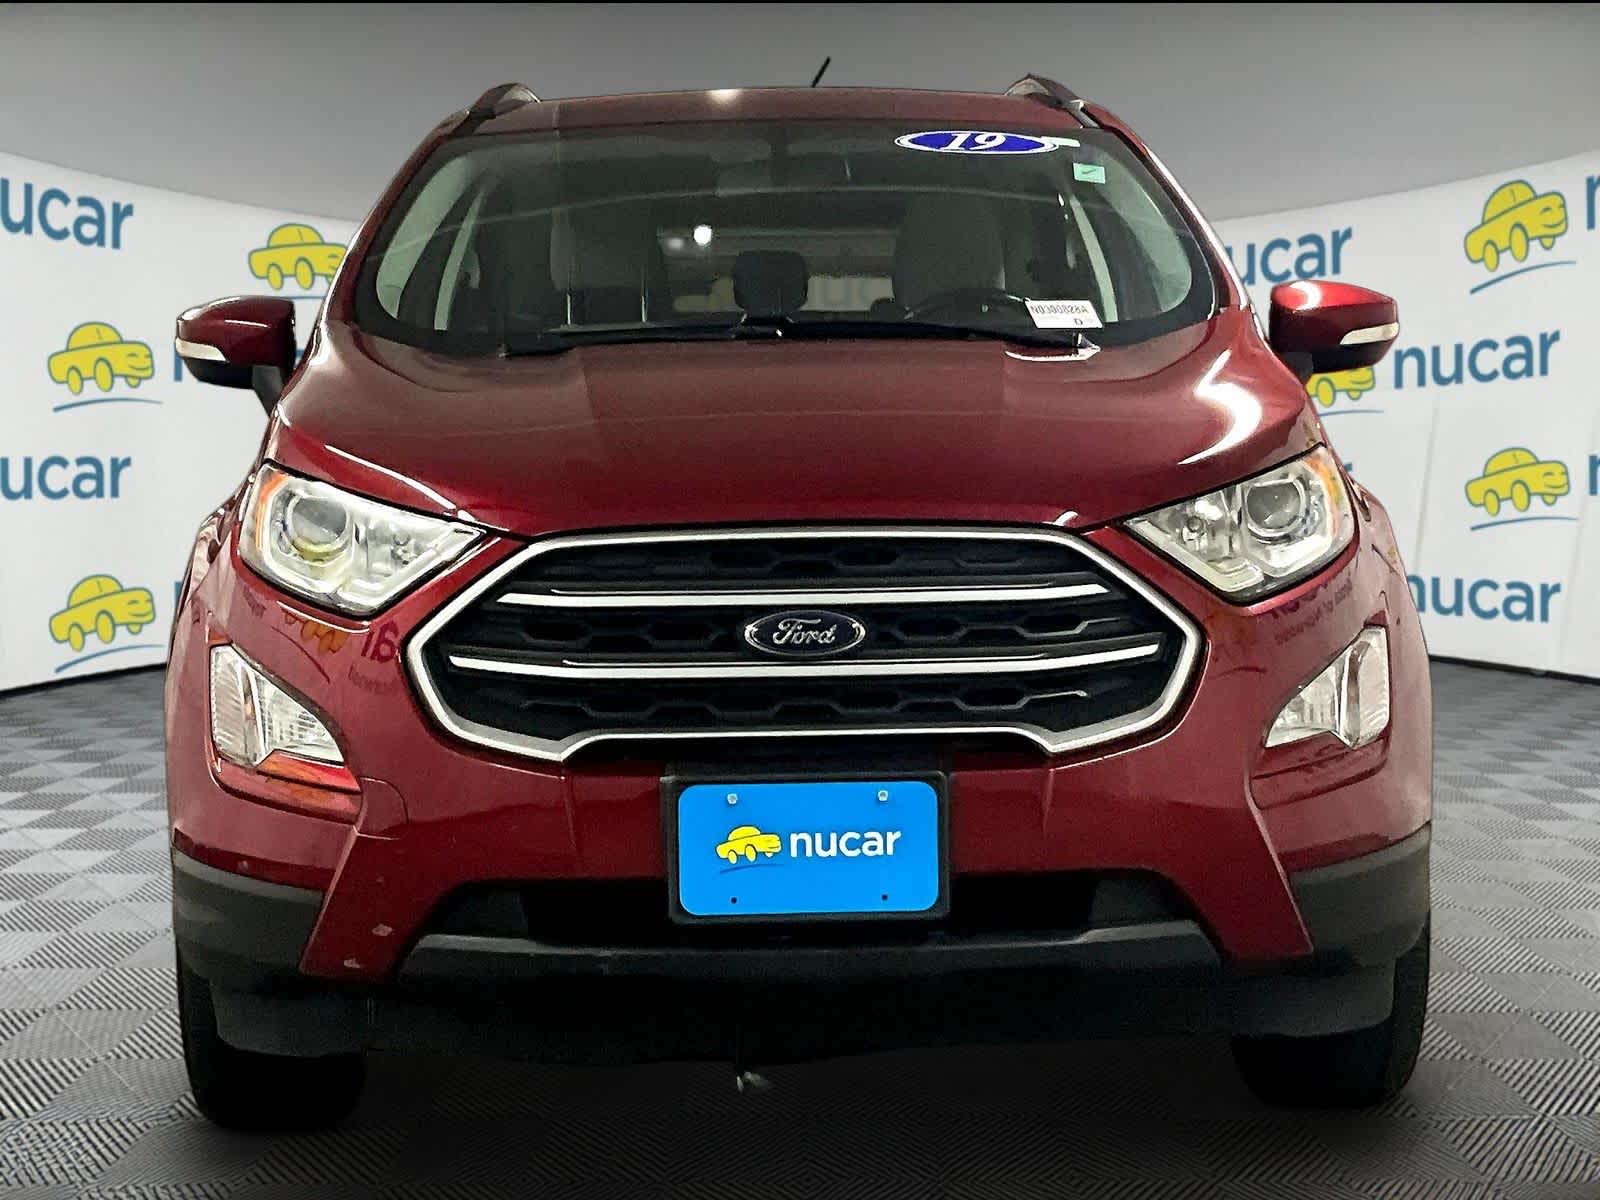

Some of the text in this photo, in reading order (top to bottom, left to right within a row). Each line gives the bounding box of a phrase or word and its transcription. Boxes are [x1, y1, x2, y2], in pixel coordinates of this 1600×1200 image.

[938, 133, 1006, 150] 19
[1394, 330, 1560, 389] nucar
[1406, 574, 1561, 623] nucar
[773, 618, 837, 644] Ford
[790, 829, 901, 857] nucar
